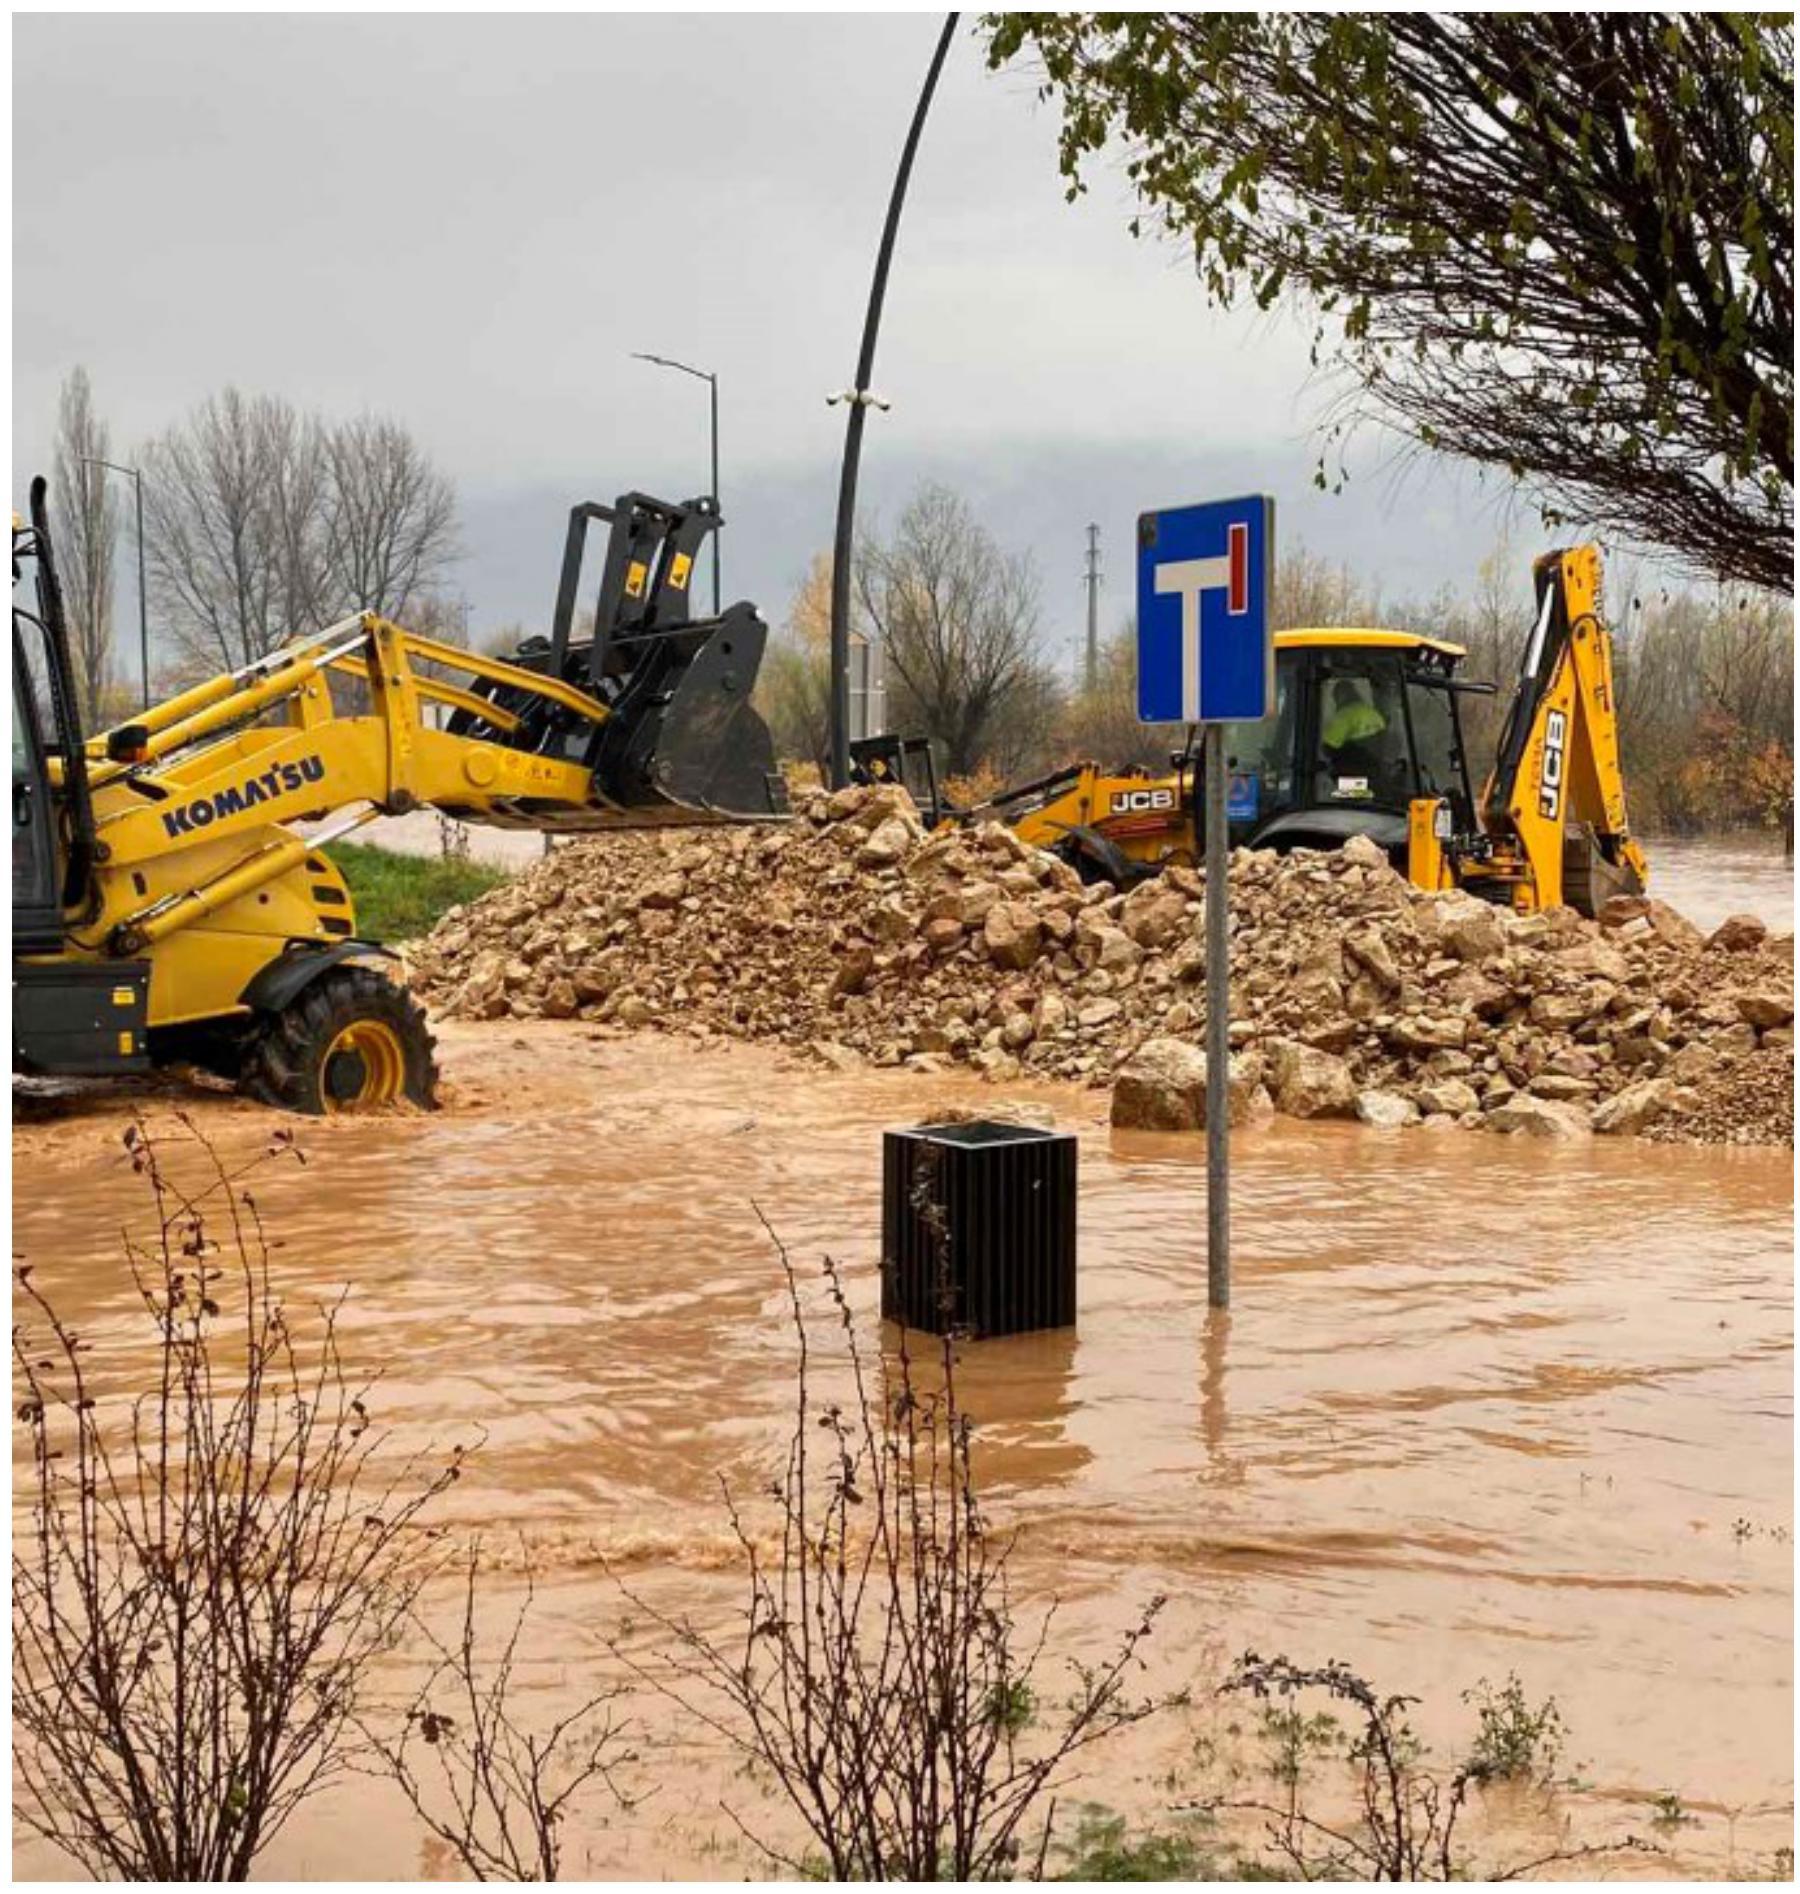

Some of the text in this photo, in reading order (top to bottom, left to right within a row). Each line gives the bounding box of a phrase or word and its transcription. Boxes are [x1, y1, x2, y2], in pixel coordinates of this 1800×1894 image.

[161, 755, 325, 838] KOMATSU
[1111, 789, 1173, 812] JCB
[1540, 710, 1565, 818] JCB
